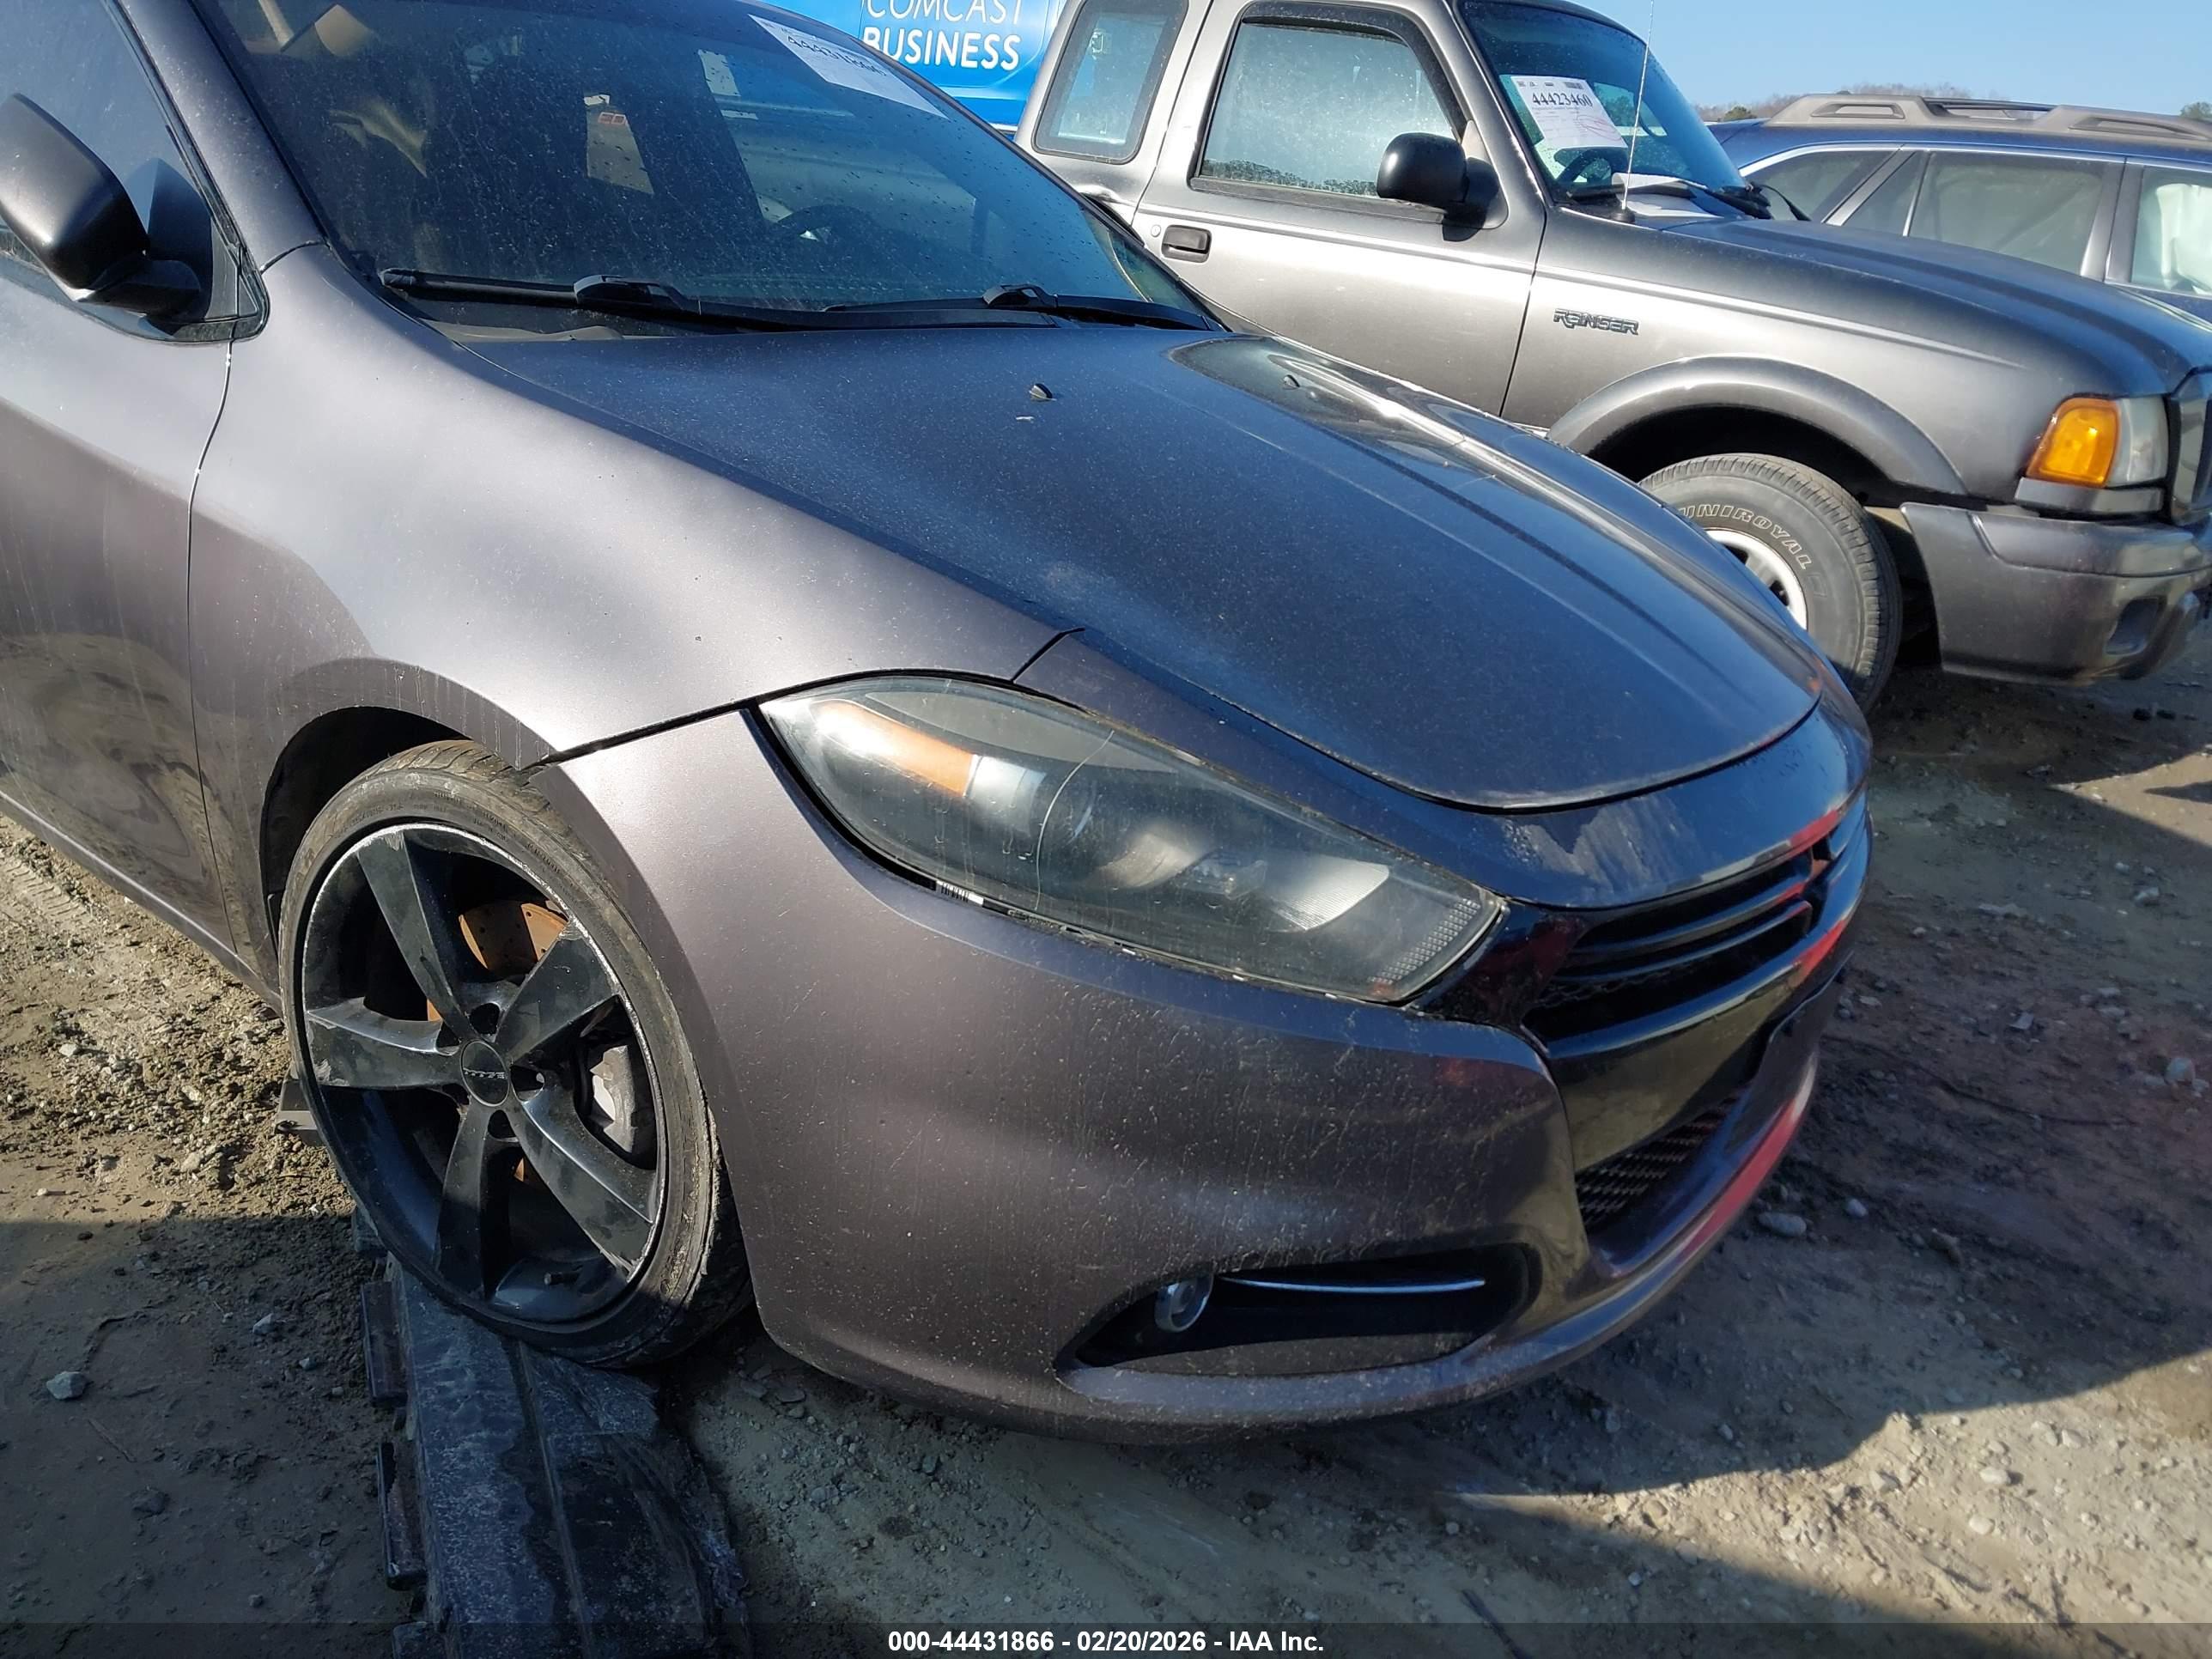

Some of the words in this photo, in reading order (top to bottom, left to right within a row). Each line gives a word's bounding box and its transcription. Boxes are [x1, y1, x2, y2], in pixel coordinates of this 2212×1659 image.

[863, 27, 1021, 70] BUSINESS
[1532, 92, 1593, 106] 44423460
[1553, 308, 1639, 335] RANGER
